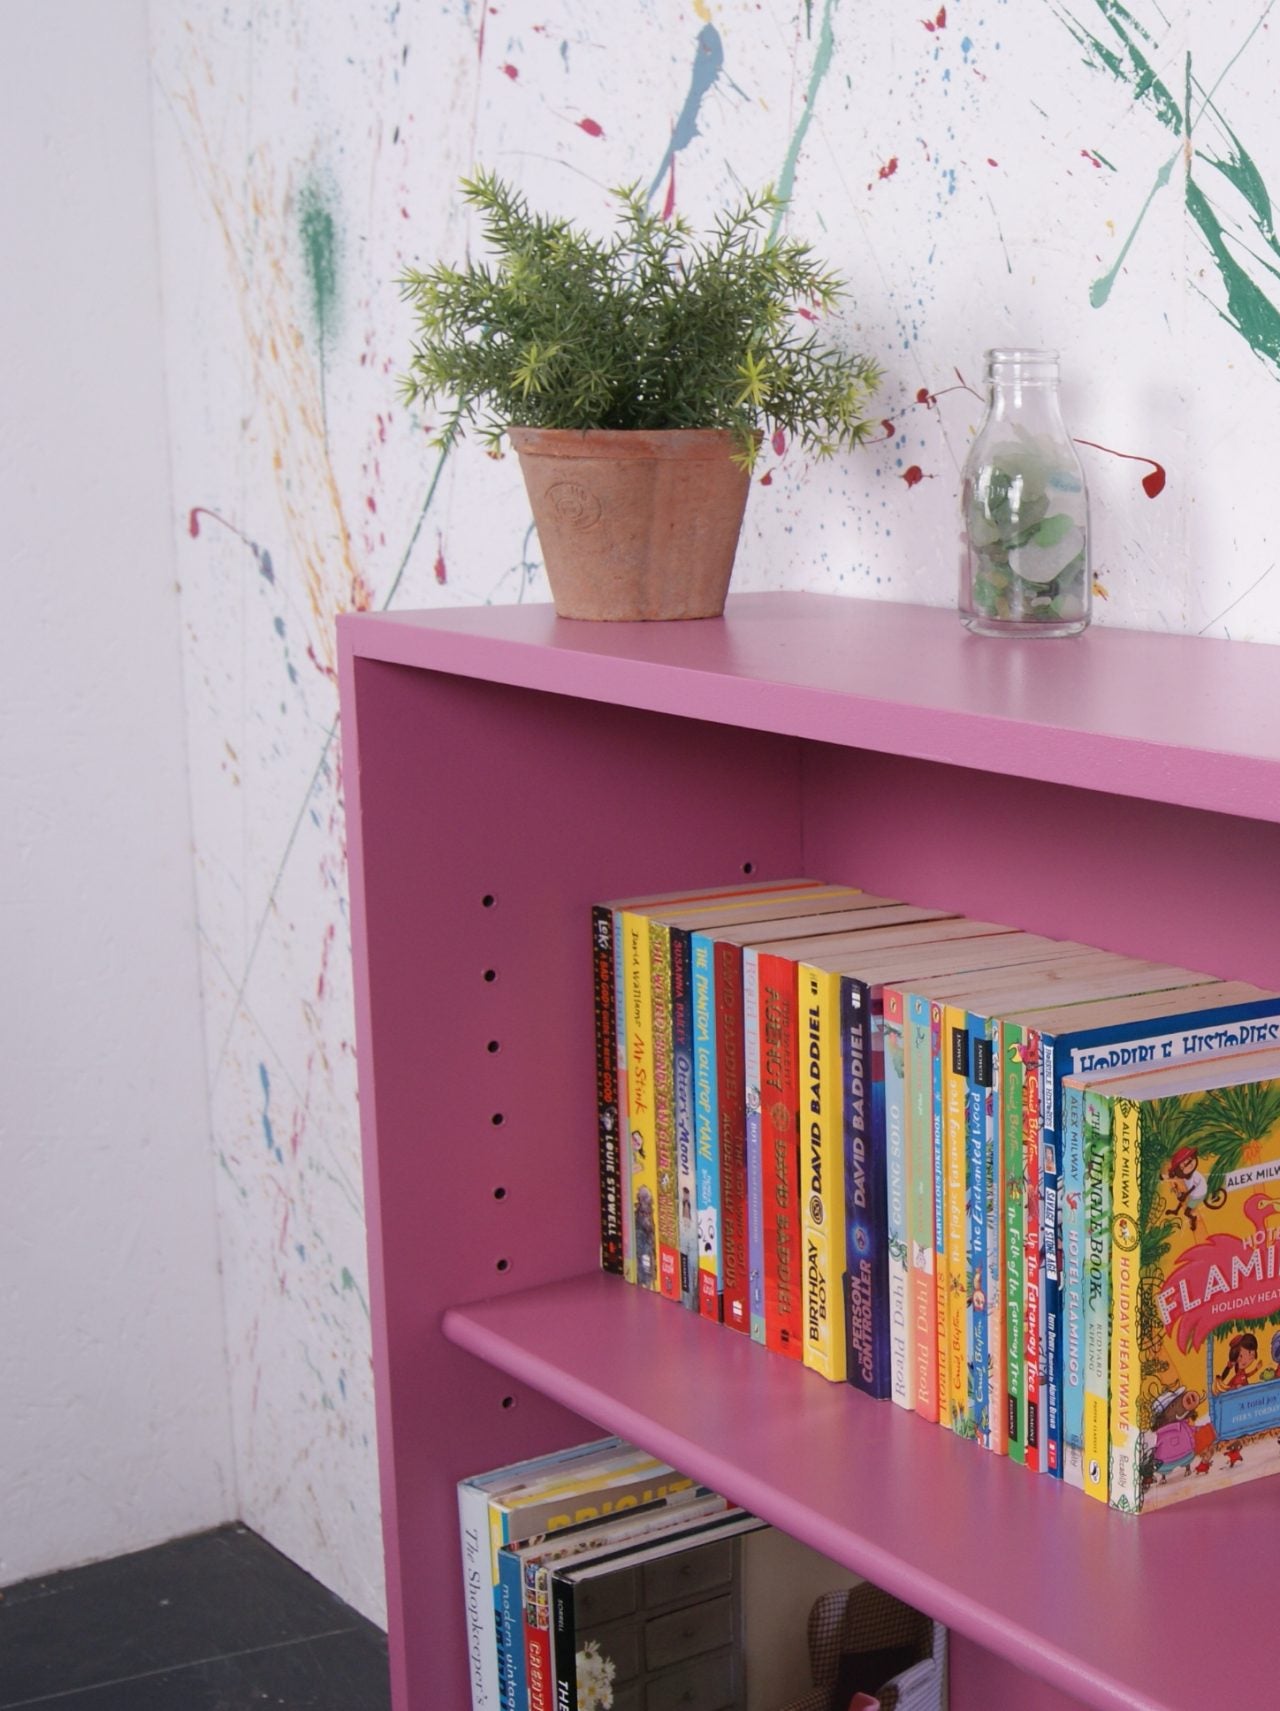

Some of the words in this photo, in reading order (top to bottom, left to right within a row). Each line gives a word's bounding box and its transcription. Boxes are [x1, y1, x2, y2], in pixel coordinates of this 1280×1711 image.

[601, 961, 609, 981] BAD
[674, 940, 686, 998] SUSANNA
[696, 947, 709, 971] THE
[723, 950, 735, 1008] DAVID
[676, 1002, 687, 1045] BAILEY
[696, 974, 711, 1041] PHANTOM
[633, 1034, 646, 1061] Mr
[724, 1014, 738, 1100] BADDIEL
[765, 987, 786, 1092] AGENCY
[810, 1005, 822, 1116] BADDIEL
[1183, 1023, 1279, 1055] HISTORIES
[604, 1072, 613, 1103] GOOD
[634, 1066, 648, 1114] Stink
[697, 1047, 712, 1113] LOLLIPOP
[851, 1024, 865, 1131] BADDIEL
[949, 1080, 958, 1114] Tree
[1008, 1073, 1020, 1110] Enid
[1029, 1076, 1039, 1114] Enid
[889, 1105, 901, 1158] SOLO
[934, 1114, 942, 1145] BOOK
[971, 1092, 982, 1135] Wood
[1071, 1096, 1079, 1127] ALEX
[1091, 1111, 1101, 1137] THE
[606, 1136, 616, 1172] LOUIE
[679, 1120, 691, 1176] Moon
[811, 1122, 823, 1195] DAVID
[935, 1146, 943, 1174] JOKE
[949, 1119, 961, 1188] Faraway
[1008, 1114, 1020, 1159] Blyton
[1029, 1118, 1039, 1166] Blyton
[1071, 1131, 1079, 1181] MILWAY
[1122, 1122, 1130, 1153] ALEX
[724, 1113, 736, 1214] ACCIDENTALLY
[775, 1139, 790, 1209] DAVID
[853, 1137, 866, 1209] DAVID
[971, 1139, 984, 1226] Enchanted
[1122, 1157, 1130, 1209] MILWAY
[1227, 1169, 1254, 1188] ALEX
[607, 1178, 618, 1237] STOWELL
[891, 1163, 902, 1226] GOING
[936, 1174, 944, 1247] MARVELLOUS
[1046, 1190, 1056, 1223] SAVAGE
[1090, 1144, 1105, 1236] JUNGLE
[950, 1192, 961, 1239] Magic
[974, 1226, 983, 1253] The
[1009, 1207, 1017, 1225] The
[725, 1218, 737, 1288] FAMOUS
[1010, 1227, 1021, 1259] Folk
[1028, 1232, 1038, 1248] Up
[1069, 1230, 1079, 1286] HOTEL
[776, 1214, 793, 1316] BADDIEL
[1008, 1260, 1020, 1277] of
[1029, 1255, 1038, 1278] The
[1047, 1258, 1057, 1274] AGE
[1089, 1238, 1104, 1312] BOOK
[808, 1239, 820, 1342] BIRTHDAY
[819, 1271, 827, 1320] BOY
[852, 1276, 863, 1351] PERSON
[892, 1275, 905, 1328] Dahl
[916, 1281, 929, 1334] Dahl
[1121, 1257, 1131, 1334] HOLIDAY
[1211, 1295, 1257, 1315] HOLIDAY
[860, 1259, 873, 1383] CONTROLLER
[953, 1310, 962, 1352] Blyton
[974, 1320, 984, 1364] Blyton
[1009, 1301, 1021, 1359] Faraway
[1028, 1282, 1039, 1357] Faraway
[1048, 1313, 1056, 1330] Terry
[1048, 1331, 1056, 1353] Deary
[1070, 1291, 1080, 1387] FLAMINGO
[894, 1337, 907, 1398] Roald
[917, 1343, 931, 1404] Roald
[954, 1354, 964, 1390] Enid
[976, 1367, 986, 1403] Enid
[1011, 1362, 1021, 1395] Tree
[1029, 1361, 1039, 1394] Tree
[1120, 1339, 1130, 1431] HEATWAVE
[1049, 1384, 1057, 1406] Martin
[1049, 1406, 1057, 1429] Brown
[1247, 1397, 1265, 1409] total
[465, 1528, 481, 1564] The
[467, 1567, 489, 1706] Shopkeeper's
[502, 1583, 516, 1647] modern
[506, 1653, 517, 1711] vintag
[558, 1680, 570, 1711] THE
